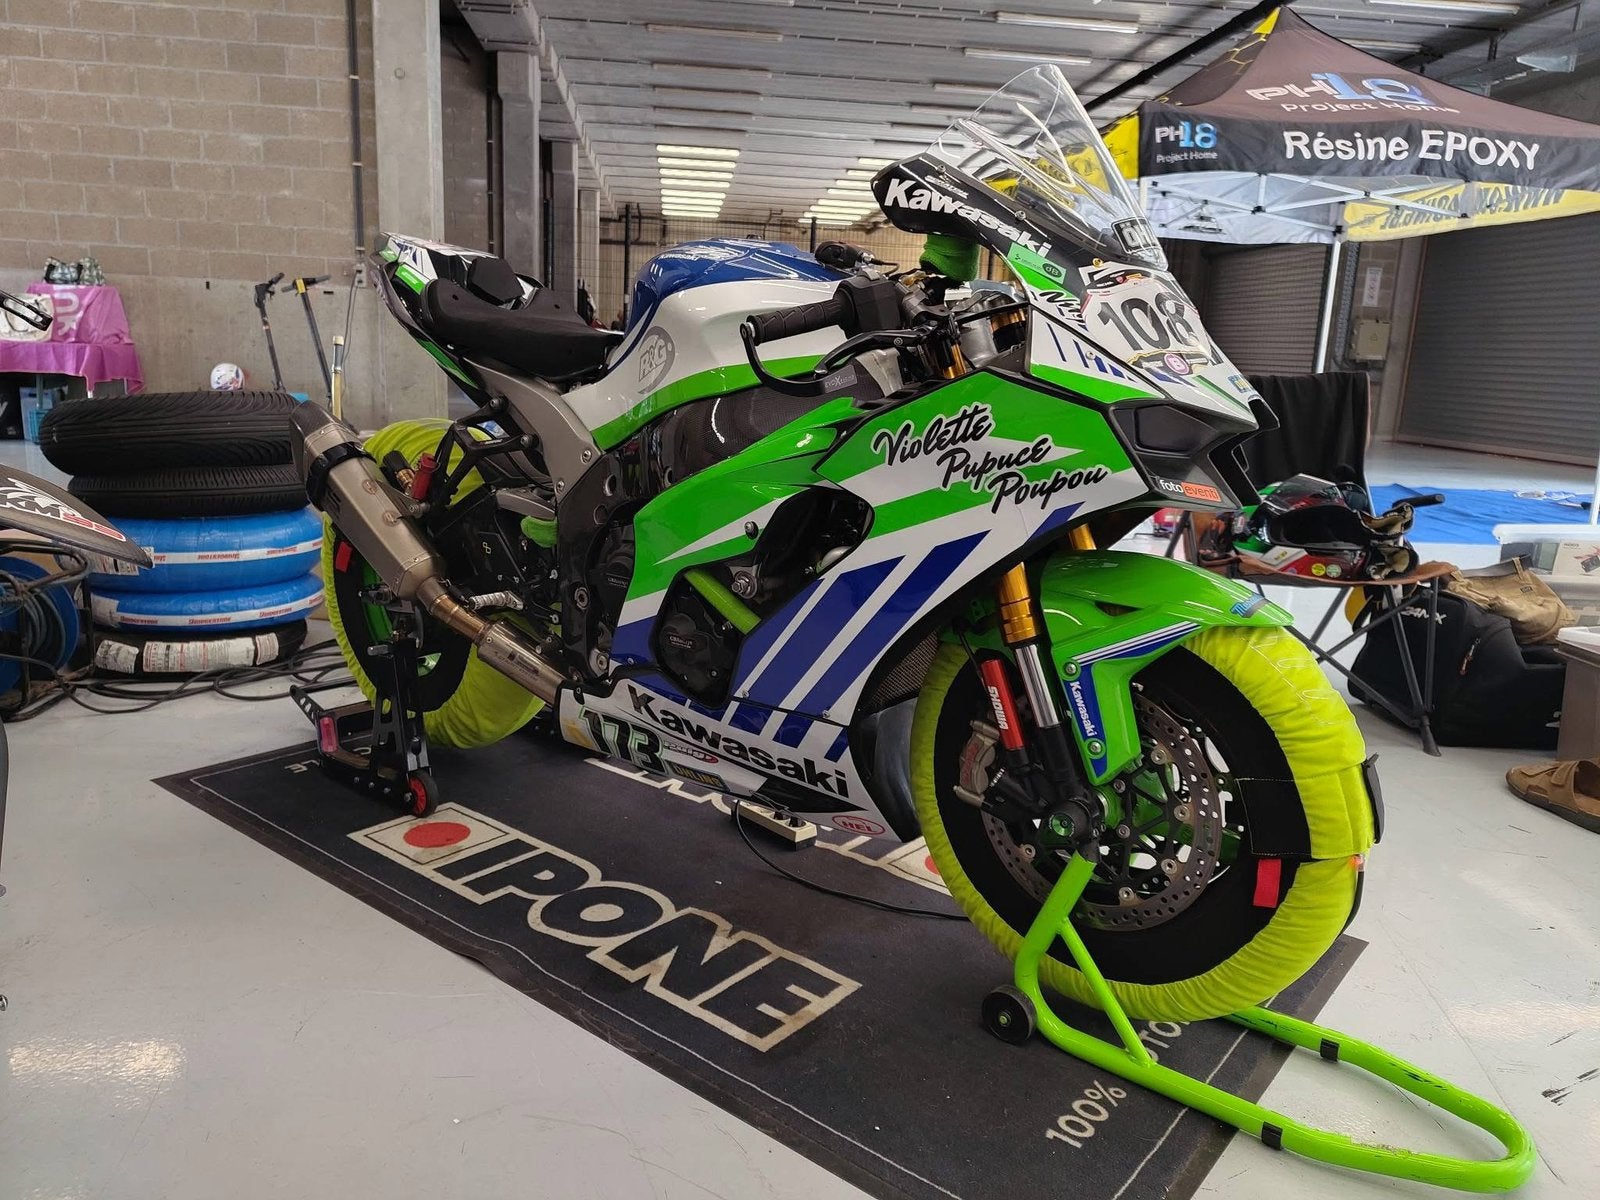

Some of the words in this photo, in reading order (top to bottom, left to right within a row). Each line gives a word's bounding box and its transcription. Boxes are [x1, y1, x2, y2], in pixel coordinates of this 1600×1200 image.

[1154, 121, 1218, 149] PH18
[1280, 102, 1378, 113] Project
[1380, 102, 1461, 113] Home
[1156, 153, 1188, 164] Project
[1189, 150, 1218, 160] Home
[1283, 129, 1409, 161] Résine
[1418, 129, 1541, 170] EPOXY
[885, 177, 1052, 258] Kawasaki
[1097, 291, 1198, 351] 108
[874, 404, 993, 467] Violette
[936, 437, 1052, 489] Pupuce
[988, 467, 1108, 514] Poupou
[1070, 681, 1098, 737] Kawasaki
[627, 684, 850, 798] Kawasaki
[428, 832, 863, 1052] IPONE
[1045, 1079, 1128, 1149] 100%
